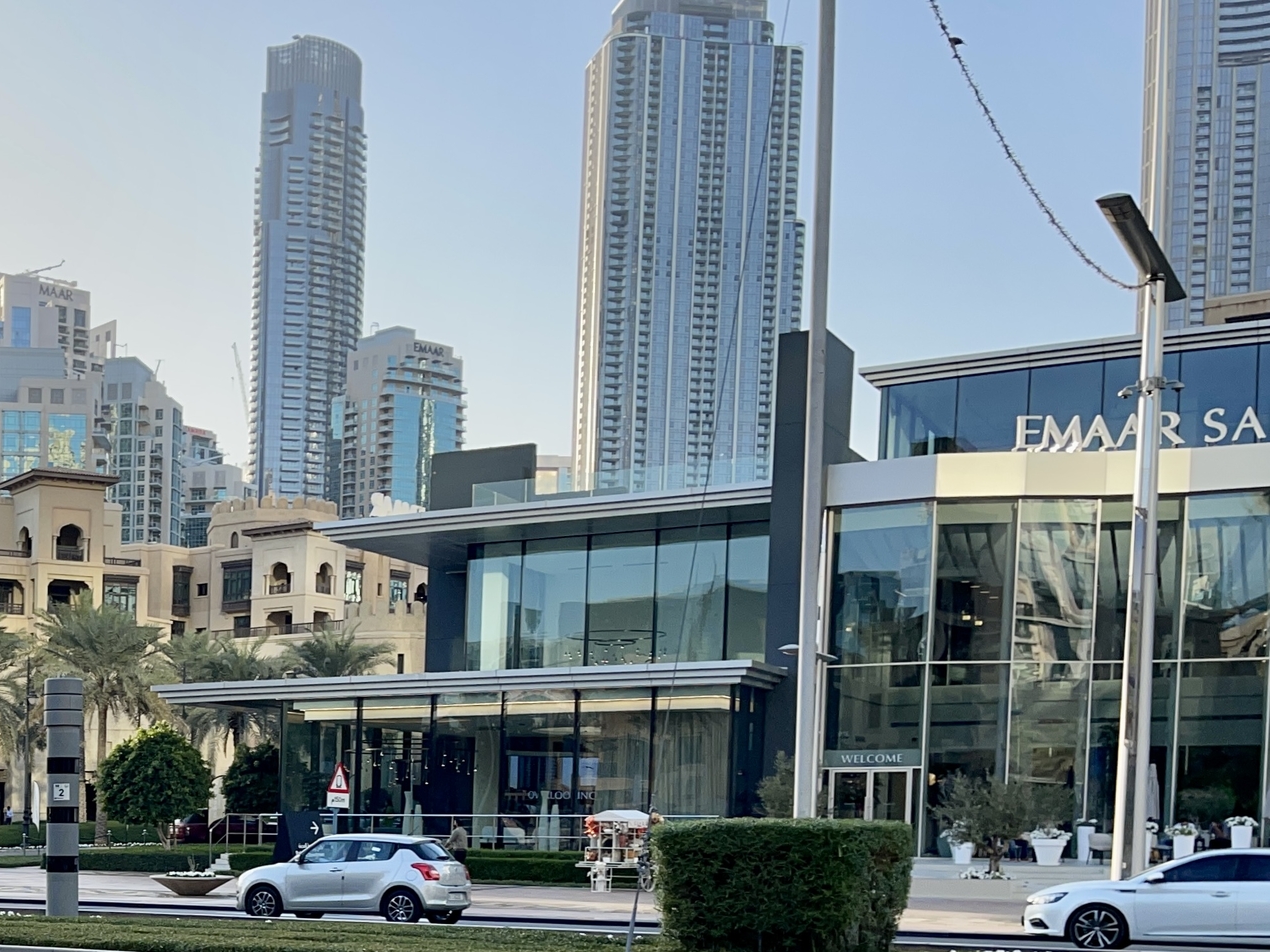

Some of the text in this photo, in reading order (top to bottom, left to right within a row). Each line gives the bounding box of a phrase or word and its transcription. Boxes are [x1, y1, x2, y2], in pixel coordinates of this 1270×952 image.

[414, 342, 444, 357] EMAAR
[1014, 410, 1185, 450] EMAAR
[841, 753, 903, 764] WELCOME
[58, 788, 65, 797] 2
